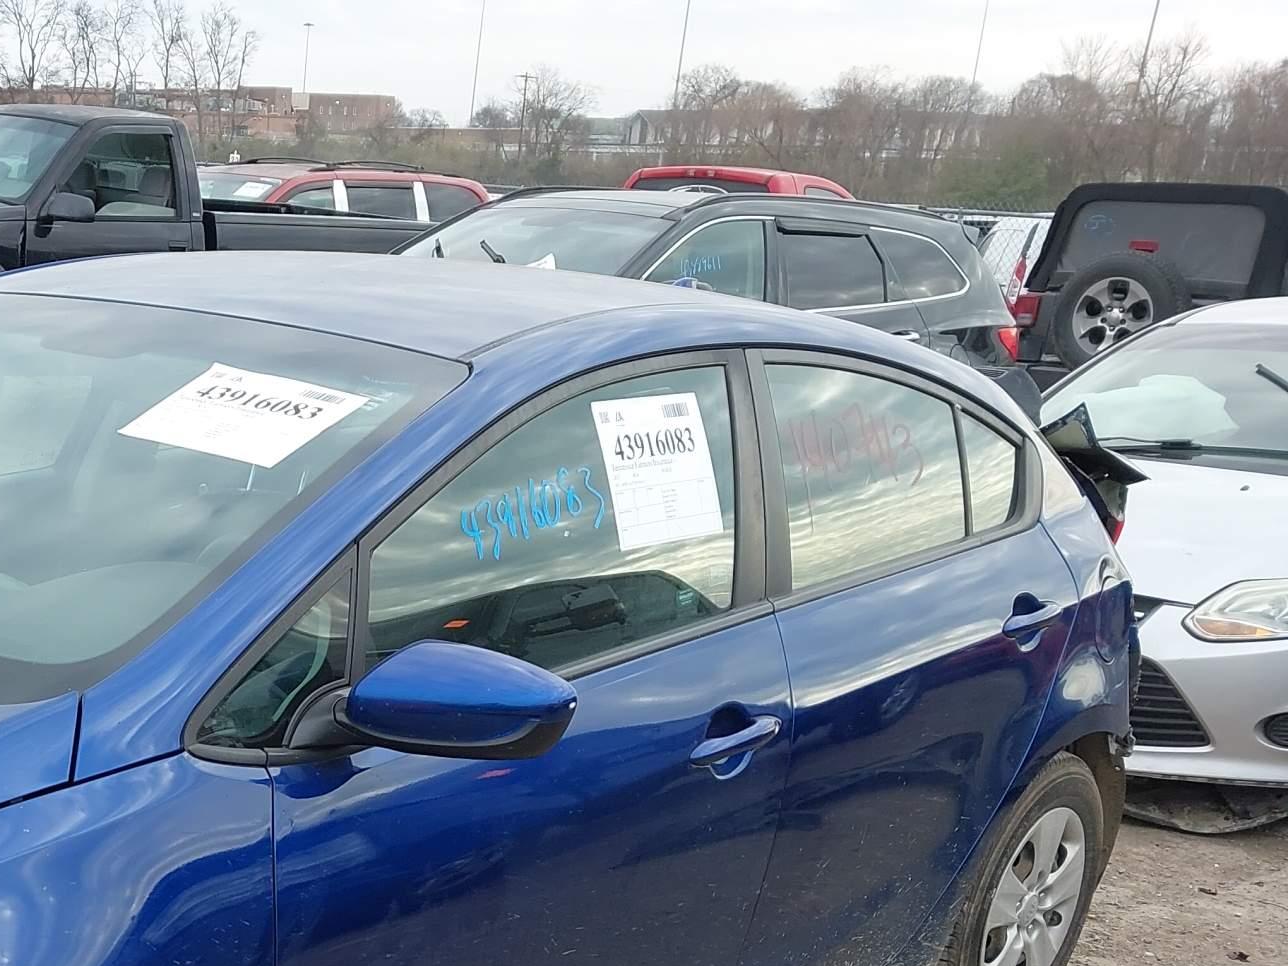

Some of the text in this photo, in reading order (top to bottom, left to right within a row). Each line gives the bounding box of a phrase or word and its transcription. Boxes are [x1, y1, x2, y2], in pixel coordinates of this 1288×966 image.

[196, 385, 324, 420] 43916083
[614, 427, 696, 461] 43916083
[461, 467, 605, 560] 43916083
